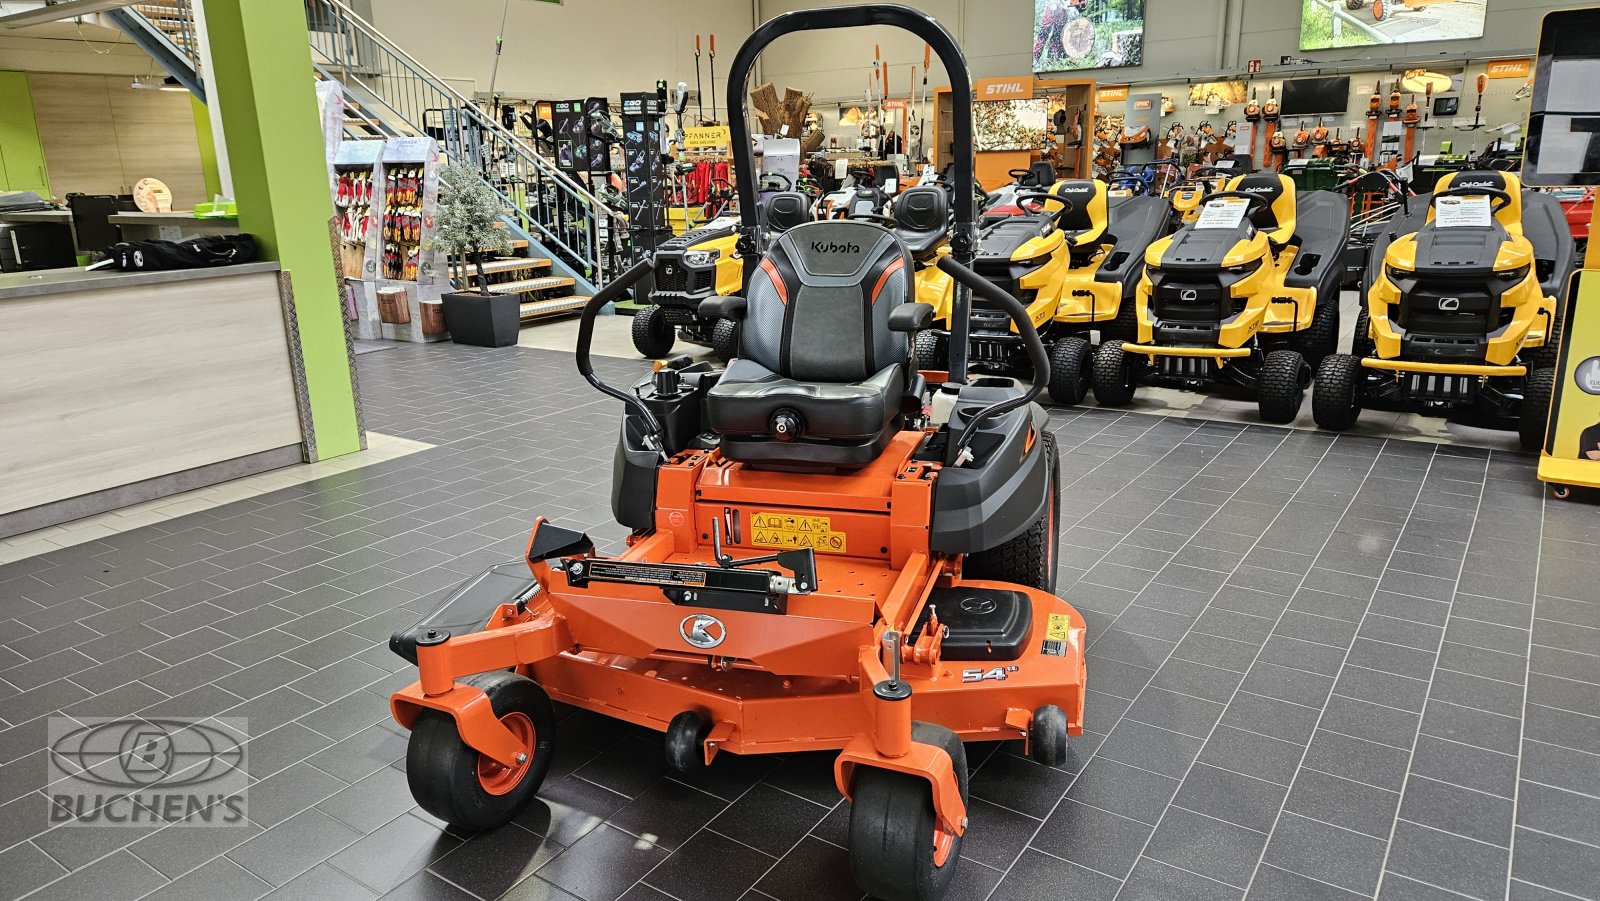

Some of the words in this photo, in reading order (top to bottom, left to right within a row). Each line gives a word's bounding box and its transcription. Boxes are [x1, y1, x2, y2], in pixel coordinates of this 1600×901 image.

[1490, 64, 1525, 73] STIHL
[985, 82, 1024, 95] STIHL
[1099, 90, 1124, 98] STIHL
[811, 241, 860, 253] Kubota
[962, 668, 1008, 683] 54
